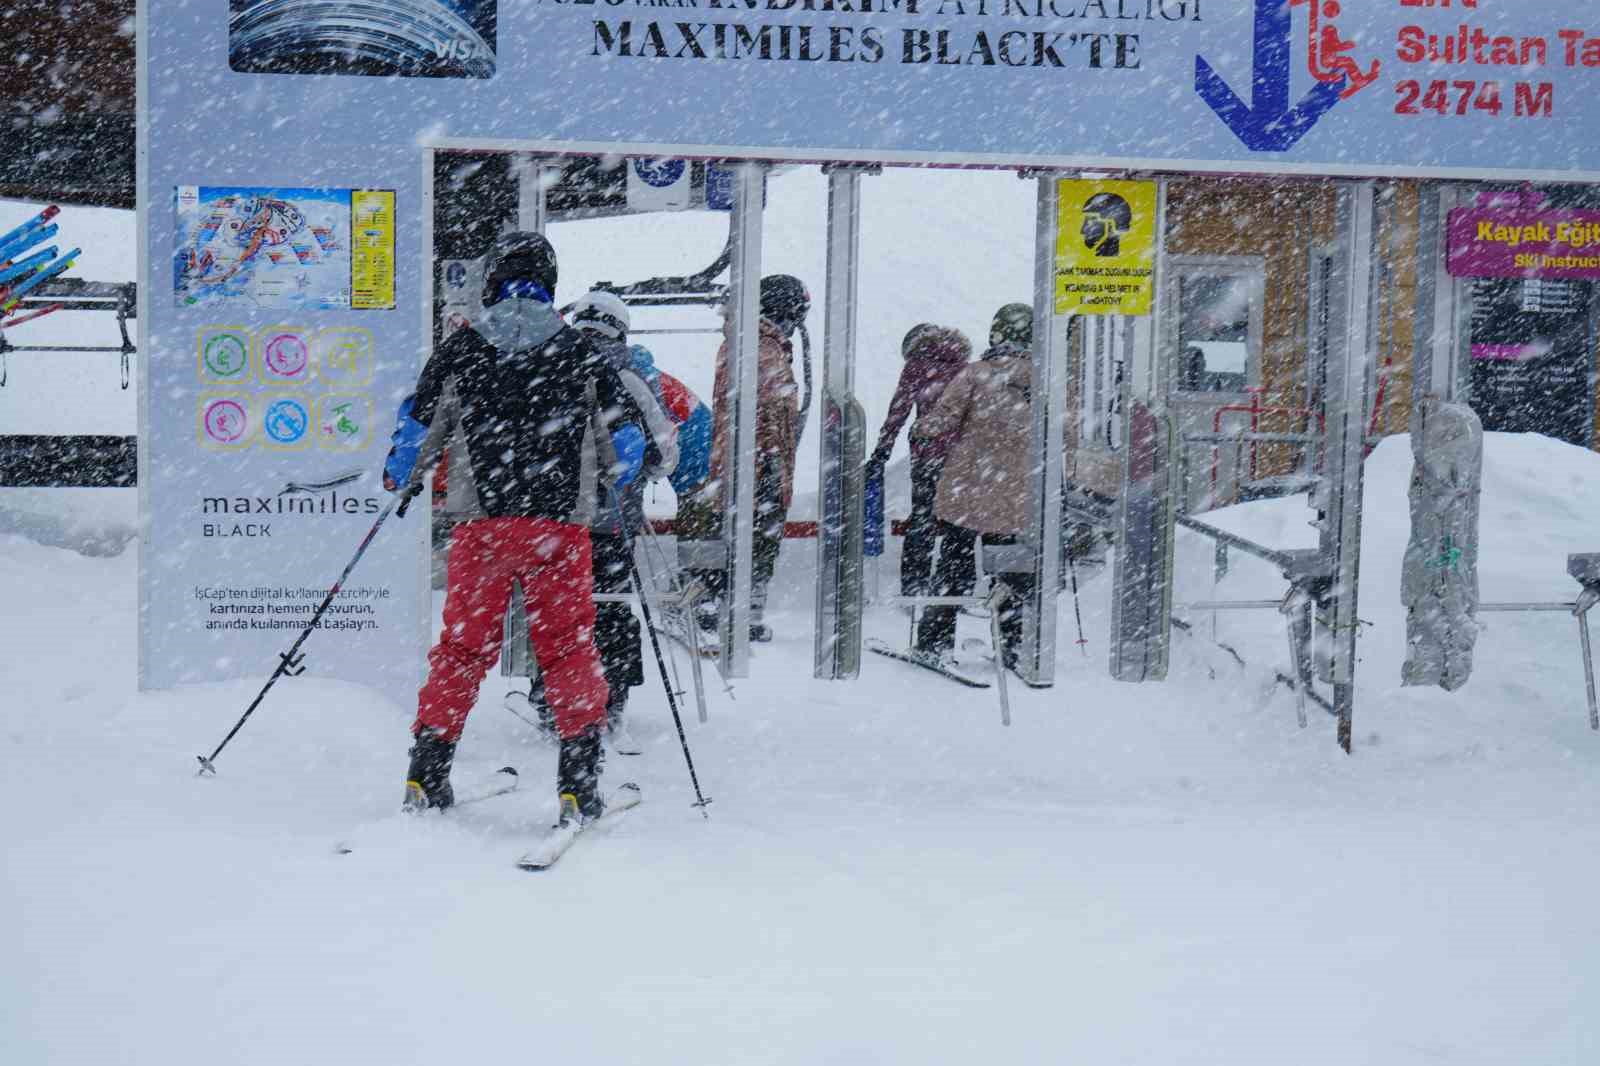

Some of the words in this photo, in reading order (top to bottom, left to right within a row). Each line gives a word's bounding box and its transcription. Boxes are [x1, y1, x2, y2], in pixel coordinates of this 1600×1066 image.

[590, 20, 885, 63] MAXIMILES
[1396, 24, 1546, 64] Sultan
[1558, 29, 1600, 67] Ta
[1394, 79, 1502, 116] 2474
[1515, 82, 1553, 117] M
[1477, 221, 1551, 246] Kayak
[1542, 254, 1600, 269] Instruc
[203, 491, 379, 514] maximiles
[203, 524, 272, 537] BLACK
[250, 587, 282, 601] dijital
[336, 586, 390, 601] ercihiyle
[210, 602, 264, 614] kartınıza
[267, 602, 310, 614] hemen
[313, 602, 375, 616] bşvurun,
